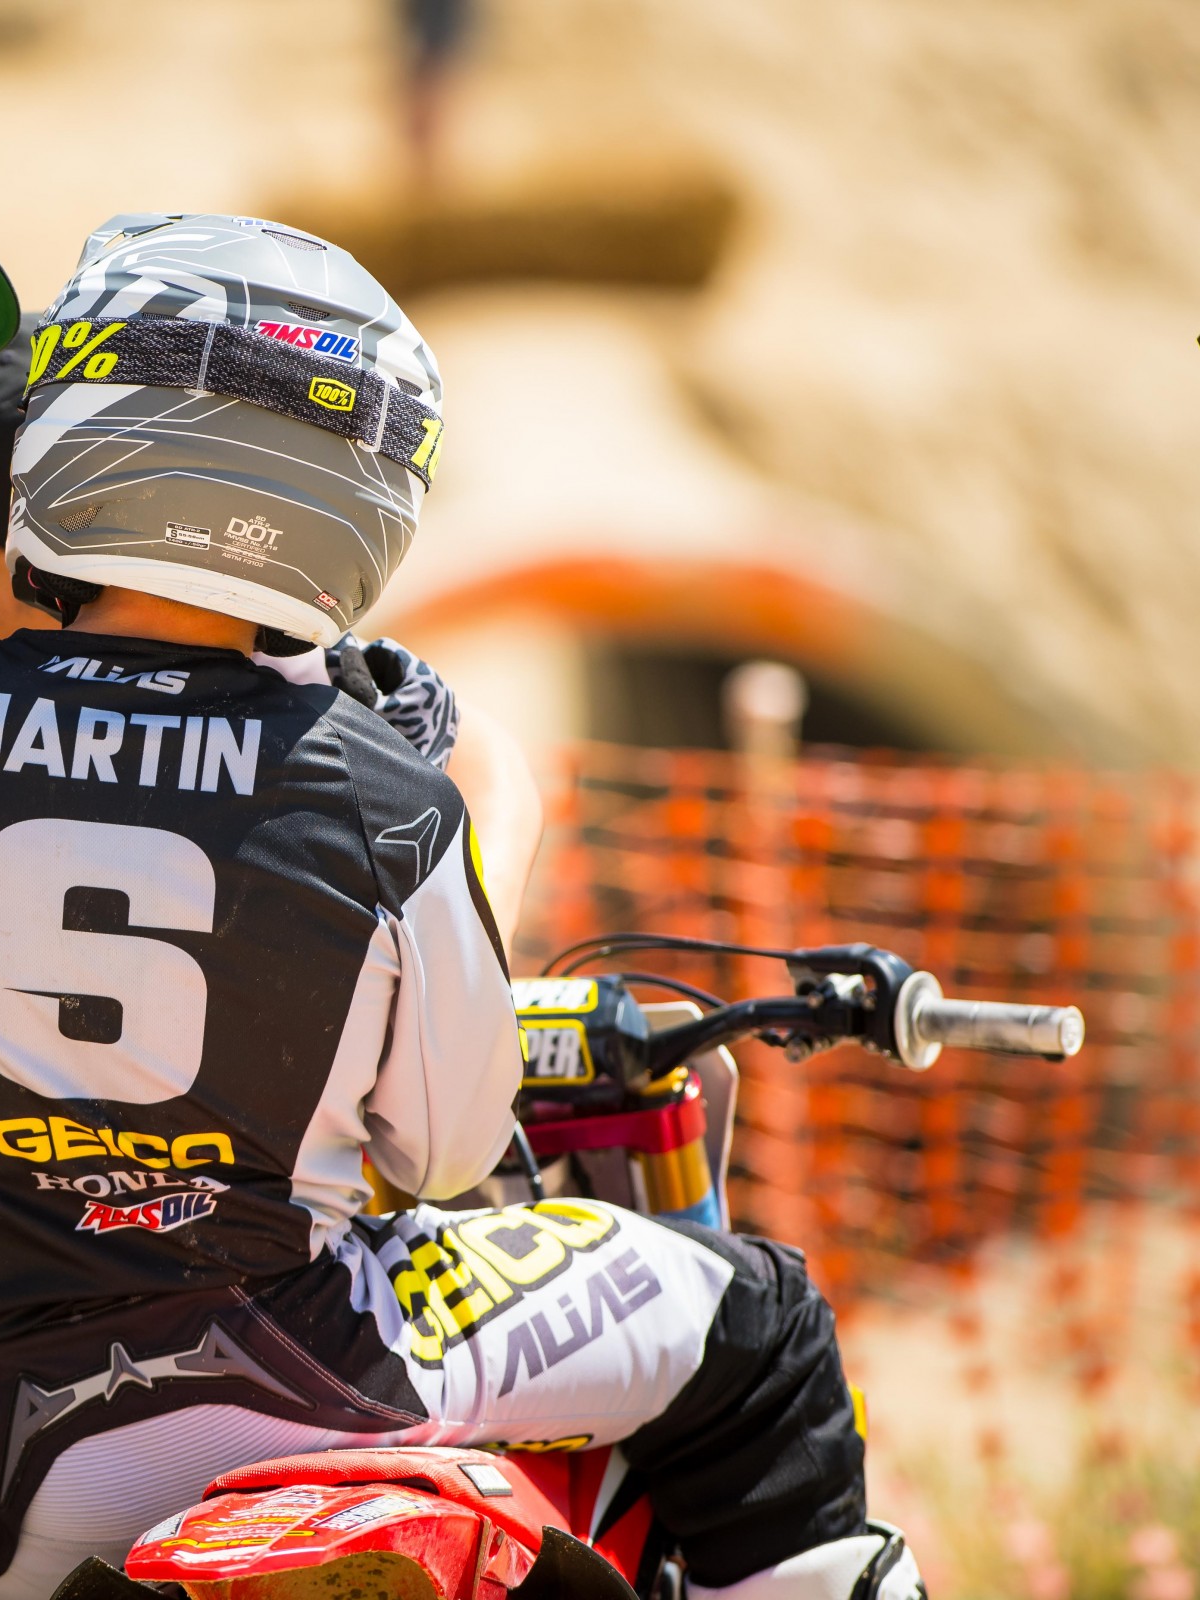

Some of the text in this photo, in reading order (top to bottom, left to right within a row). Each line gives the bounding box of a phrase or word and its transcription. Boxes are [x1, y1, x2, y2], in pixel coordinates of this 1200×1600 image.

[256, 321, 360, 360] AMSOIL
[315, 384, 351, 407] 100%
[171, 529, 178, 538] S
[226, 517, 284, 546] DOT
[221, 552, 242, 562] ASTM
[31, 1170, 231, 1198] HONDA
[76, 1192, 218, 1234] AMSOIL
[393, 1201, 618, 1363] GEICO
